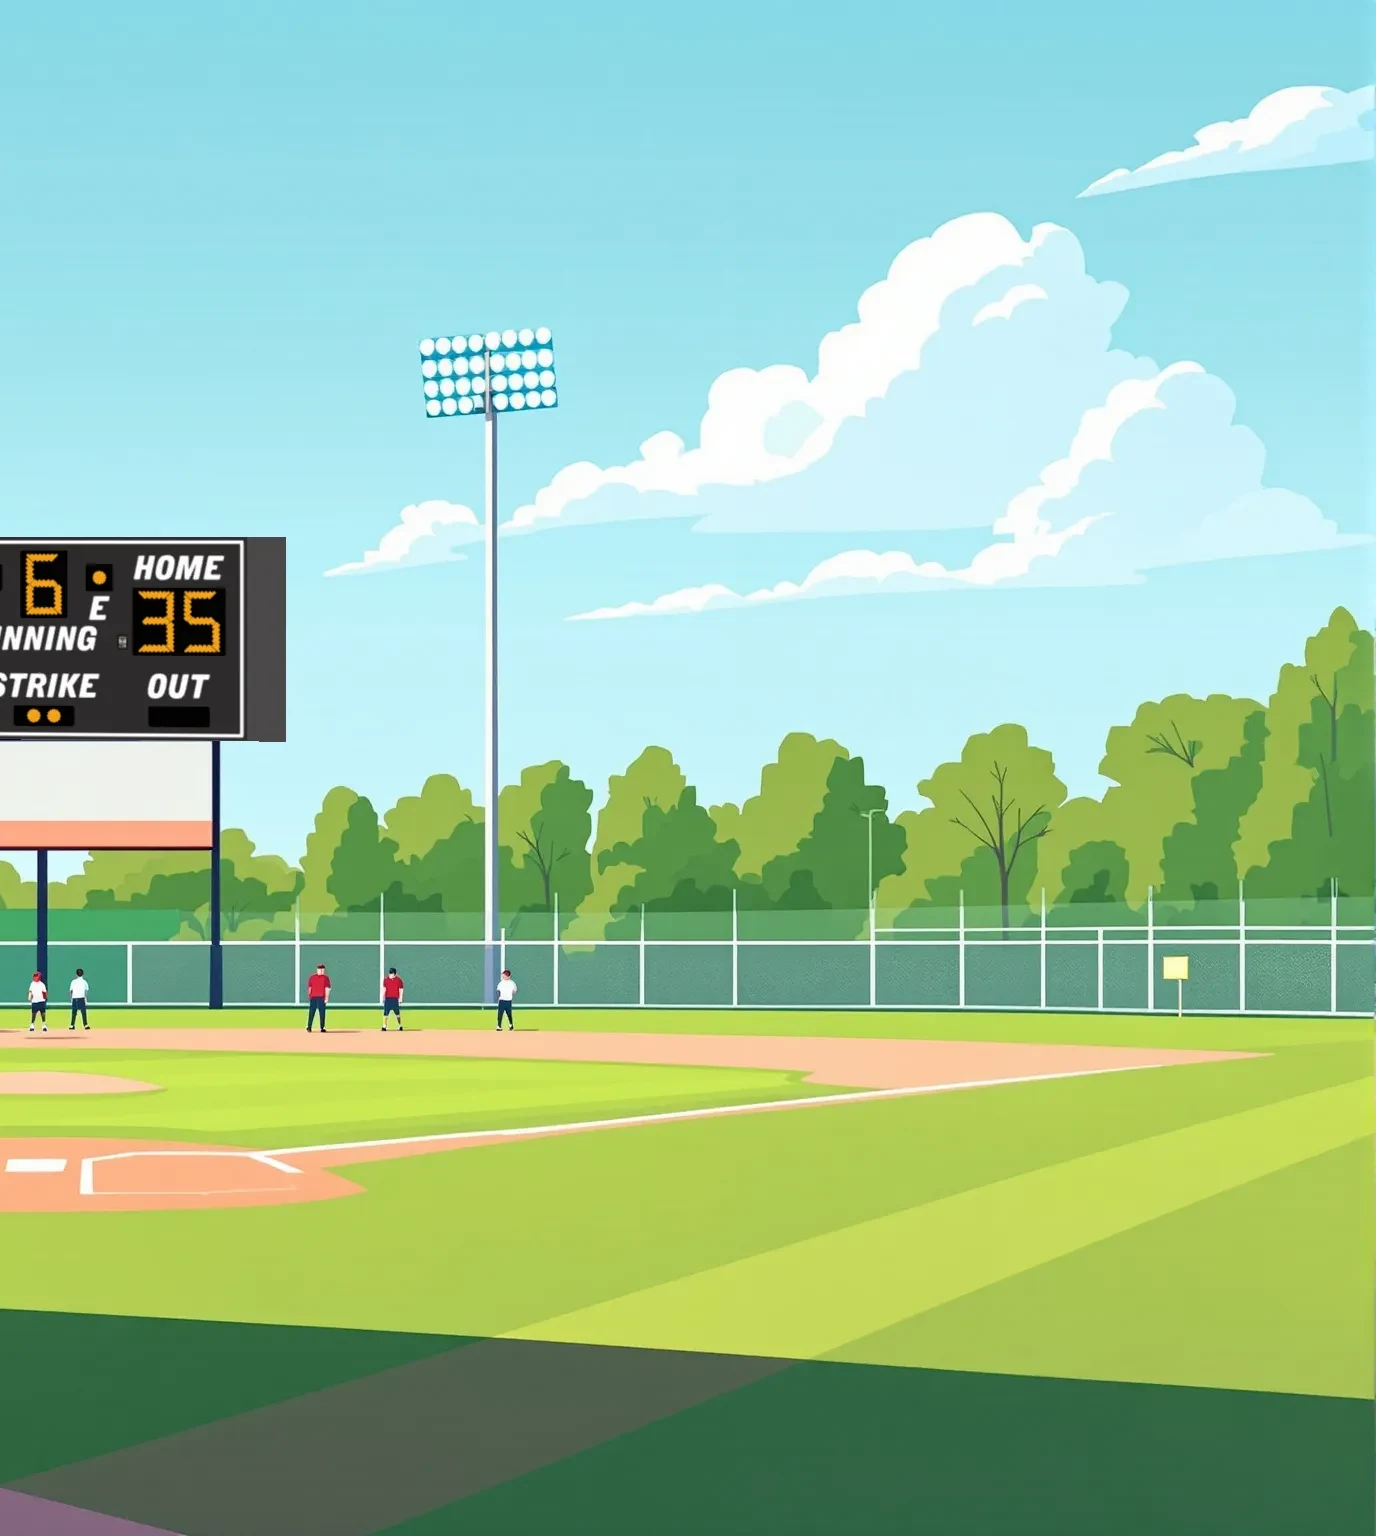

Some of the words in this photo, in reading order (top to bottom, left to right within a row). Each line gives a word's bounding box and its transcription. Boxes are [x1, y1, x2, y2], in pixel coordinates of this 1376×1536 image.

[134, 555, 224, 580] HOME
[26, 554, 62, 614] 6
[89, 596, 110, 620] E
[139, 591, 220, 652] 35
[148, 673, 210, 699] OUT
